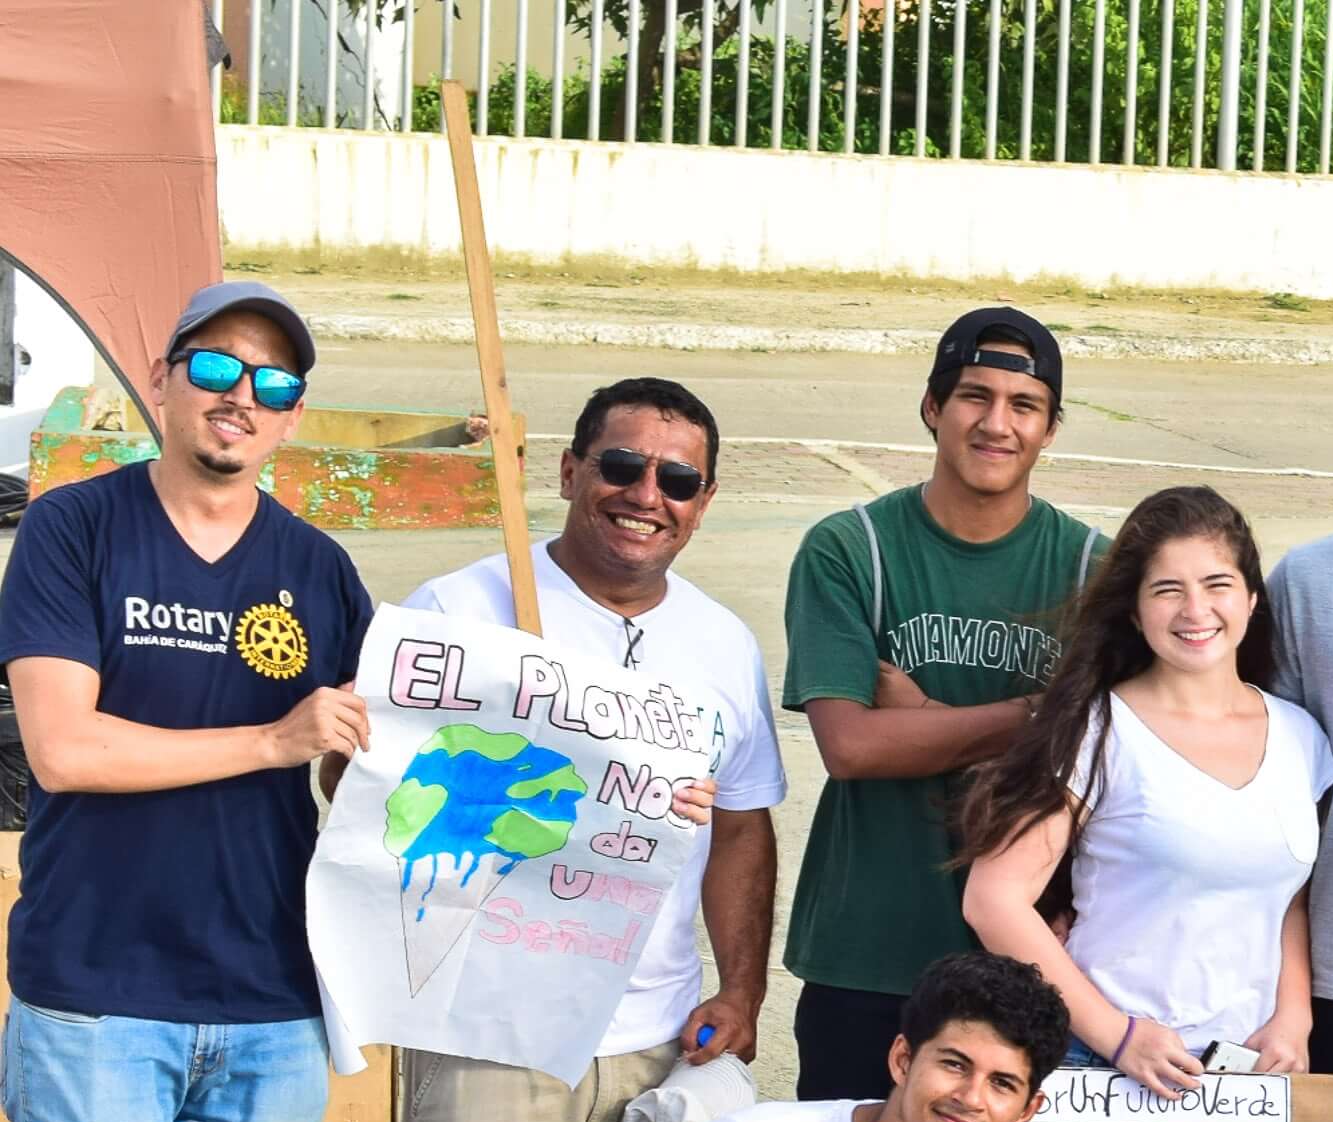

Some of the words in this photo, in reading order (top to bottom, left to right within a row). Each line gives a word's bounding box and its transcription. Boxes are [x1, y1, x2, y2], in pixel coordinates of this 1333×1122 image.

[124, 634, 159, 646] BAHÍA
[160, 637, 176, 647] DE
[125, 597, 233, 642] Rotary
[389, 639, 481, 711] EL
